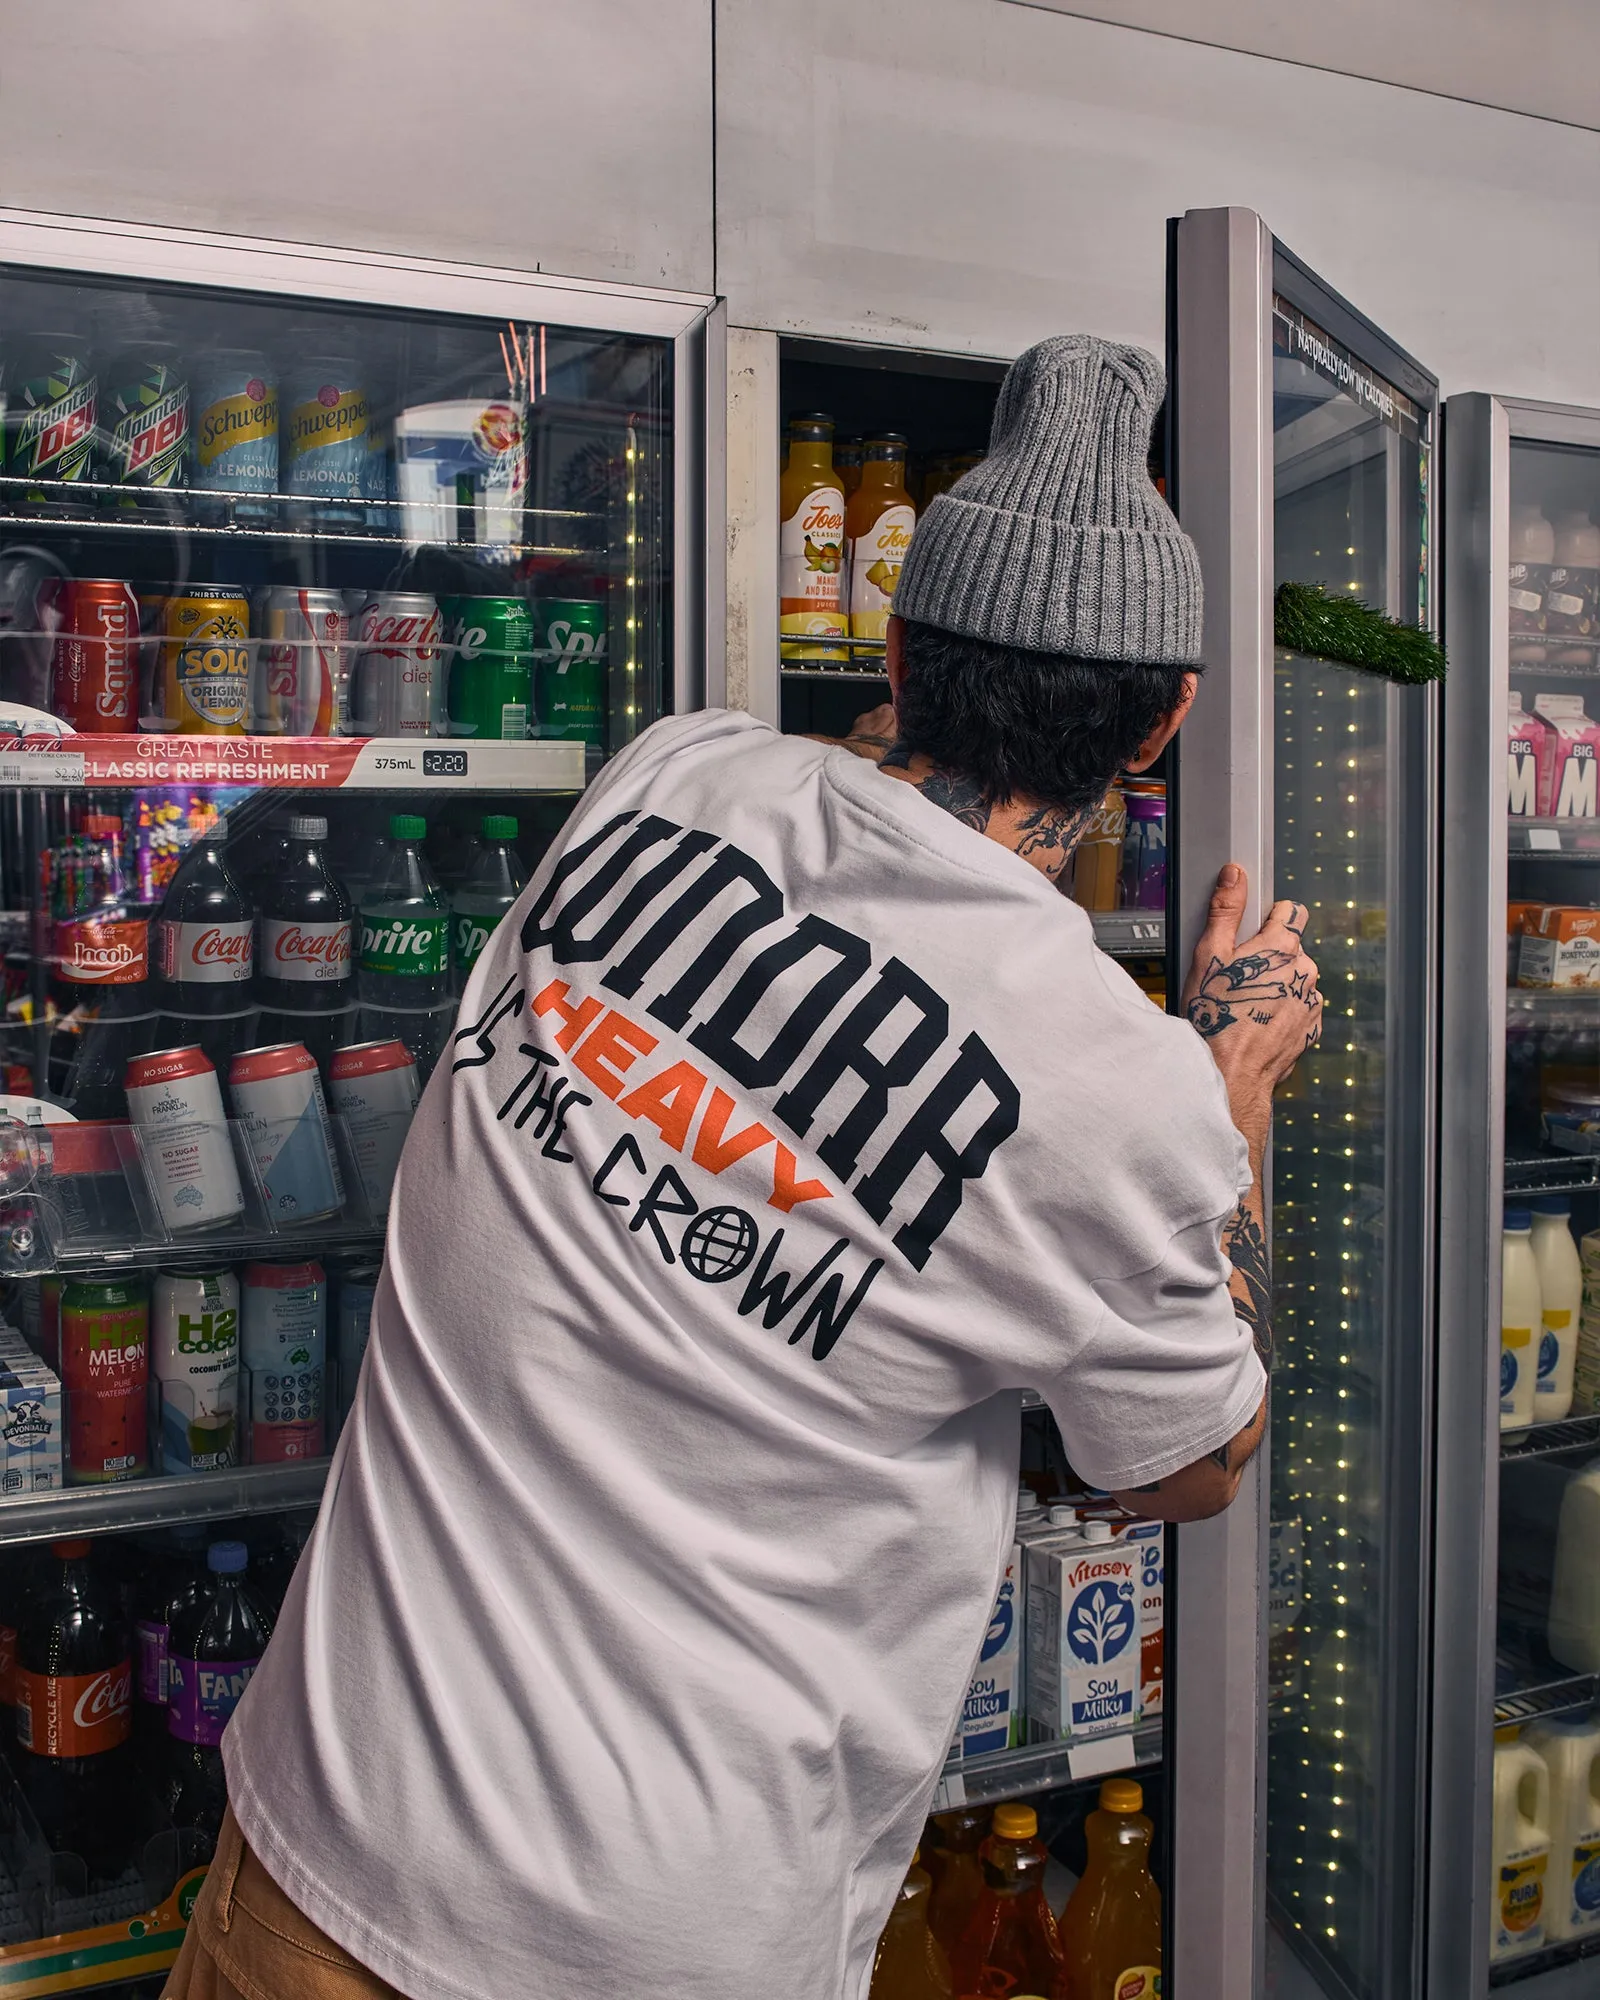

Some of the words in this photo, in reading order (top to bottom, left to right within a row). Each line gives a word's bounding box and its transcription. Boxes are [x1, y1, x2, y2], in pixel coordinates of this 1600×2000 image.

[1338, 359, 1356, 389] LOW
[294, 469, 360, 486] LEMONADE
[802, 506, 844, 532] Joe's
[805, 585, 821, 596] AND
[96, 601, 133, 718] Squad
[185, 648, 249, 676] SOLO
[402, 665, 432, 683] diet
[201, 697, 243, 708] LEMON
[137, 741, 201, 758] GREAT
[215, 742, 273, 759] TASTE
[1510, 741, 1532, 754] BIG
[1573, 745, 1593, 758] BIG
[182, 762, 330, 780] REFRESHMENT
[375, 758, 416, 770] 375mL
[426, 755, 464, 772] $2.20
[55, 768, 84, 779] $2.20
[1556, 757, 1597, 818] M
[1574, 941, 1589, 949] ICED
[72, 942, 133, 968] Jacob
[314, 966, 338, 978] diet
[143, 1069, 155, 1078] NO
[157, 1063, 184, 1076] SUGAR
[158, 1098, 180, 1107] MOUNT
[531, 978, 834, 1214] HEAVY
[152, 1101, 188, 1115] FRANKLIN
[162, 1151, 174, 1159] NO
[175, 1145, 200, 1156] SUGAR
[496, 1042, 593, 1164] THE
[592, 1133, 886, 1361] CROWN
[201, 1303, 225, 1313] NATURAL
[89, 1317, 145, 1350] H2
[178, 1308, 237, 1342] H2
[279, 1334, 286, 1343] 5
[89, 1342, 145, 1366] MELON
[89, 1358, 145, 1377] WATER
[189, 1364, 222, 1375] COCONUT
[113, 1378, 131, 1389] PURE
[5, 1423, 49, 1438] DEVONDALE
[105, 1458, 116, 1468] NO
[193, 1455, 204, 1464] NO
[47, 1677, 57, 1697] ME
[1087, 1678, 1119, 1699] Soy
[963, 1695, 1000, 1719] Milky
[1081, 1699, 1124, 1721] Milky
[47, 1700, 57, 1755] RECYCLE
[964, 1718, 995, 1733] Regular
